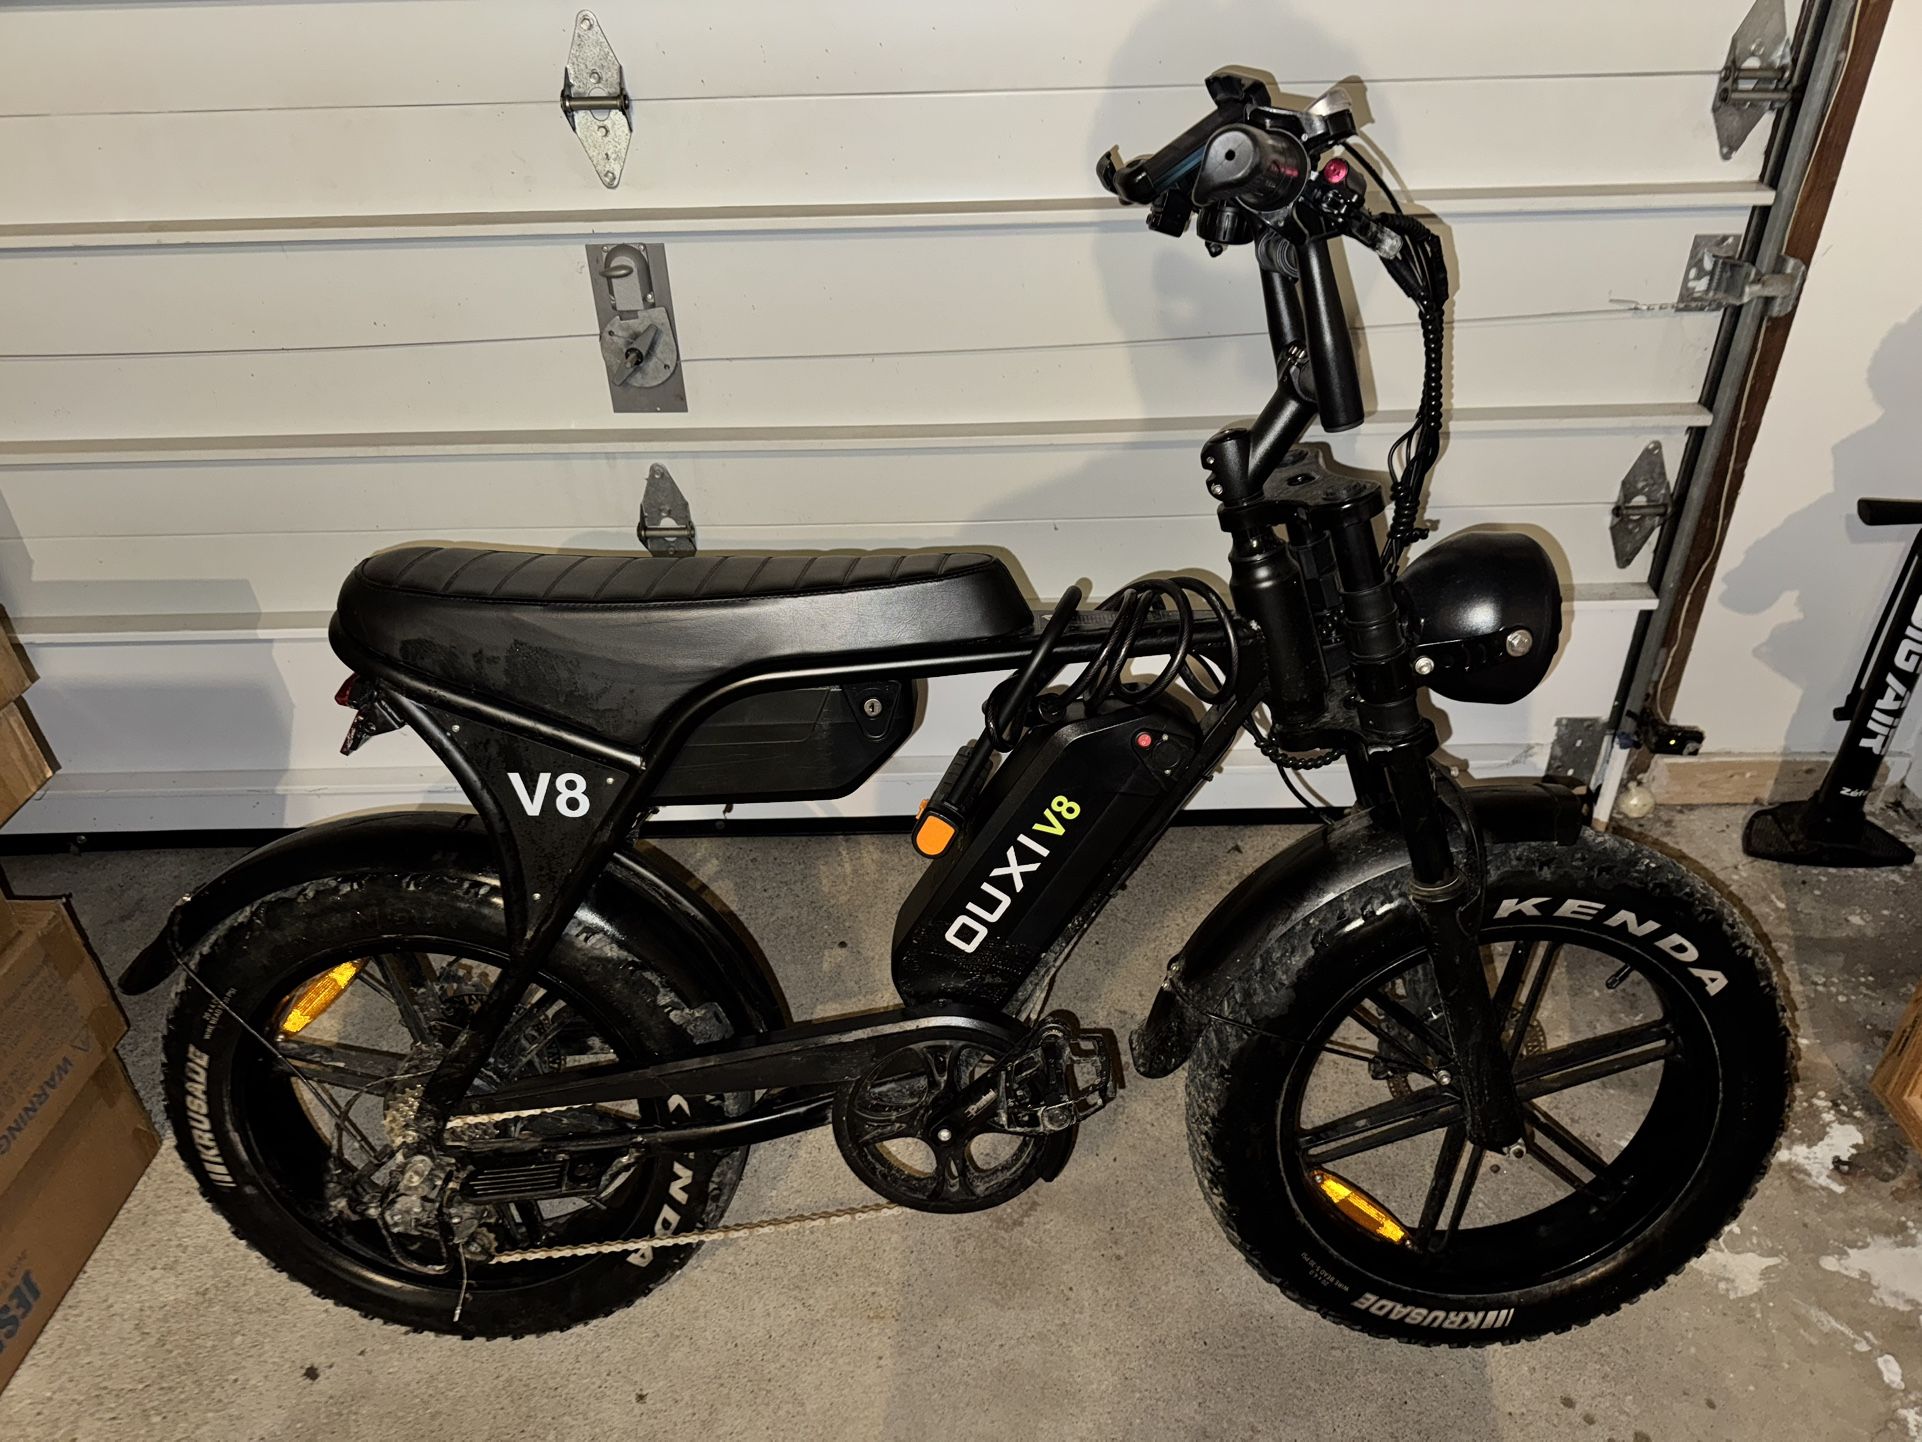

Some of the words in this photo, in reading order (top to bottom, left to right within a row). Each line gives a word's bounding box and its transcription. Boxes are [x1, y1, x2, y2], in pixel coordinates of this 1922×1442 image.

[1859, 672, 1911, 756] AIR
[507, 772, 590, 818] V8
[945, 834, 1050, 954] OUXI
[1032, 795, 1081, 836] V8
[1493, 897, 1729, 997] KENDA
[0, 1056, 74, 1156] WARNING
[185, 1043, 224, 1164] KRUSADE
[626, 1094, 694, 1268] KNDA
[0, 1271, 41, 1353] JES
[1351, 1292, 1487, 1330] KRUSADE
